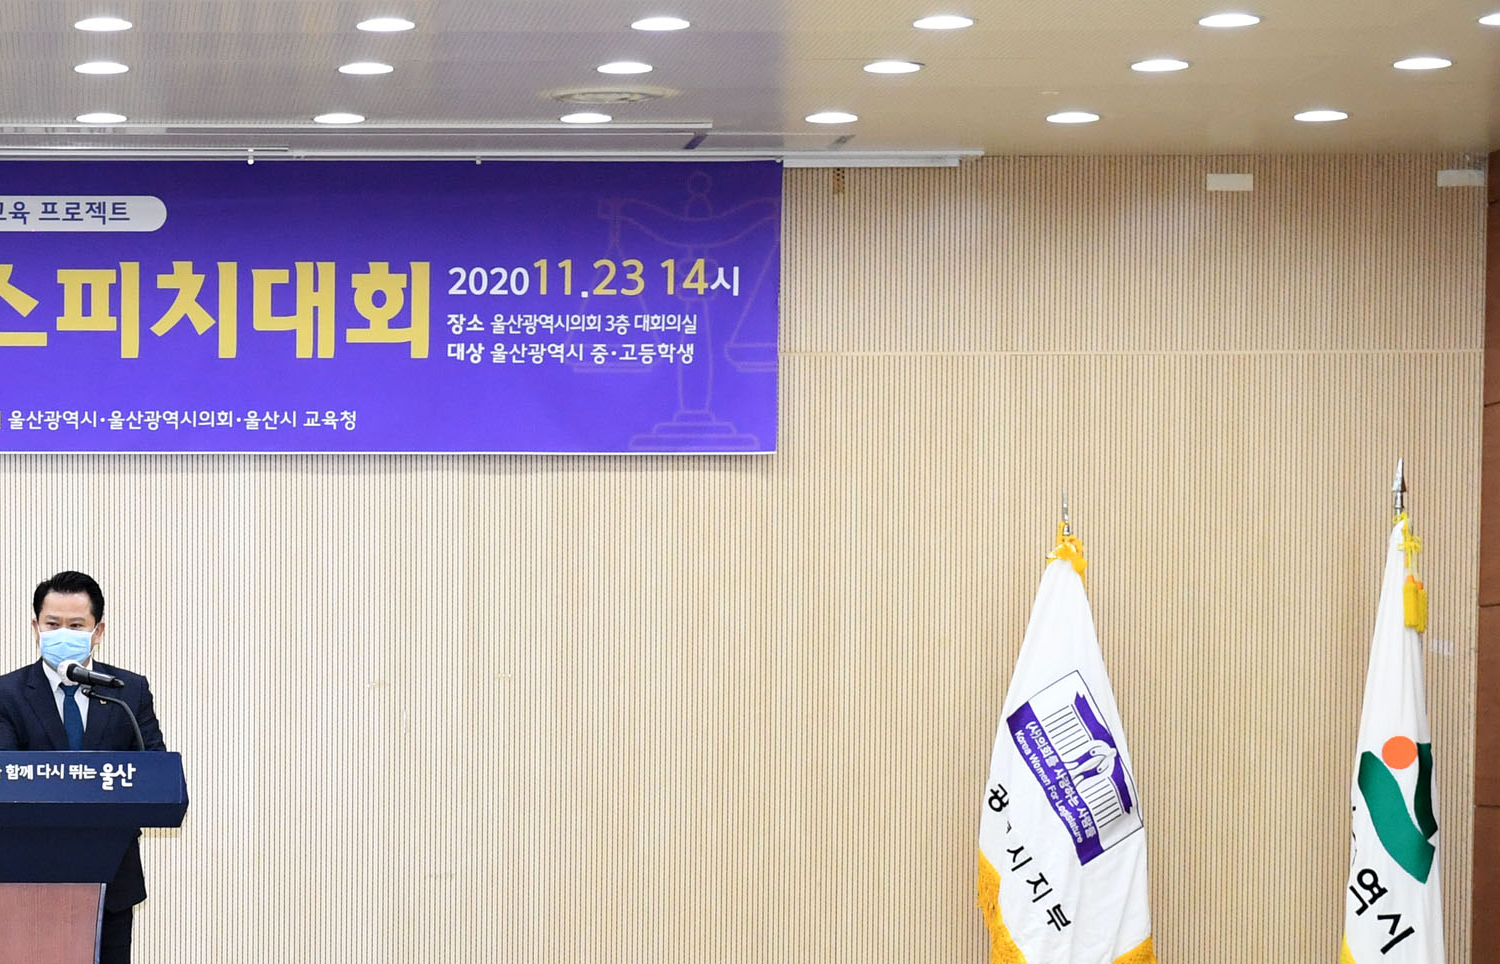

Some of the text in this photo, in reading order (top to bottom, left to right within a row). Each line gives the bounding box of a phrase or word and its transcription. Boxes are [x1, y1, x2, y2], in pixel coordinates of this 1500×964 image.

[38, 201, 130, 225] 프로젝트
[661, 258, 740, 297] 14시
[446, 313, 697, 336] 장소 울산광역시의회 3층 대회의실
[447, 342, 694, 365] 대상 울산광역시 중·고등학생
[302, 410, 357, 431] 교육청
[5, 763, 34, 781] 함께
[36, 763, 65, 780] 다시
[68, 763, 98, 780] 뛰는
[99, 762, 137, 791] 울산
[1014, 729, 1083, 843] Korea Women For Legislature
[1054, 768, 1079, 807] 사랑하는
[1077, 806, 1097, 838] 사람들
[987, 783, 1072, 932] 광시지부
[1348, 828, 1416, 956] 역시
